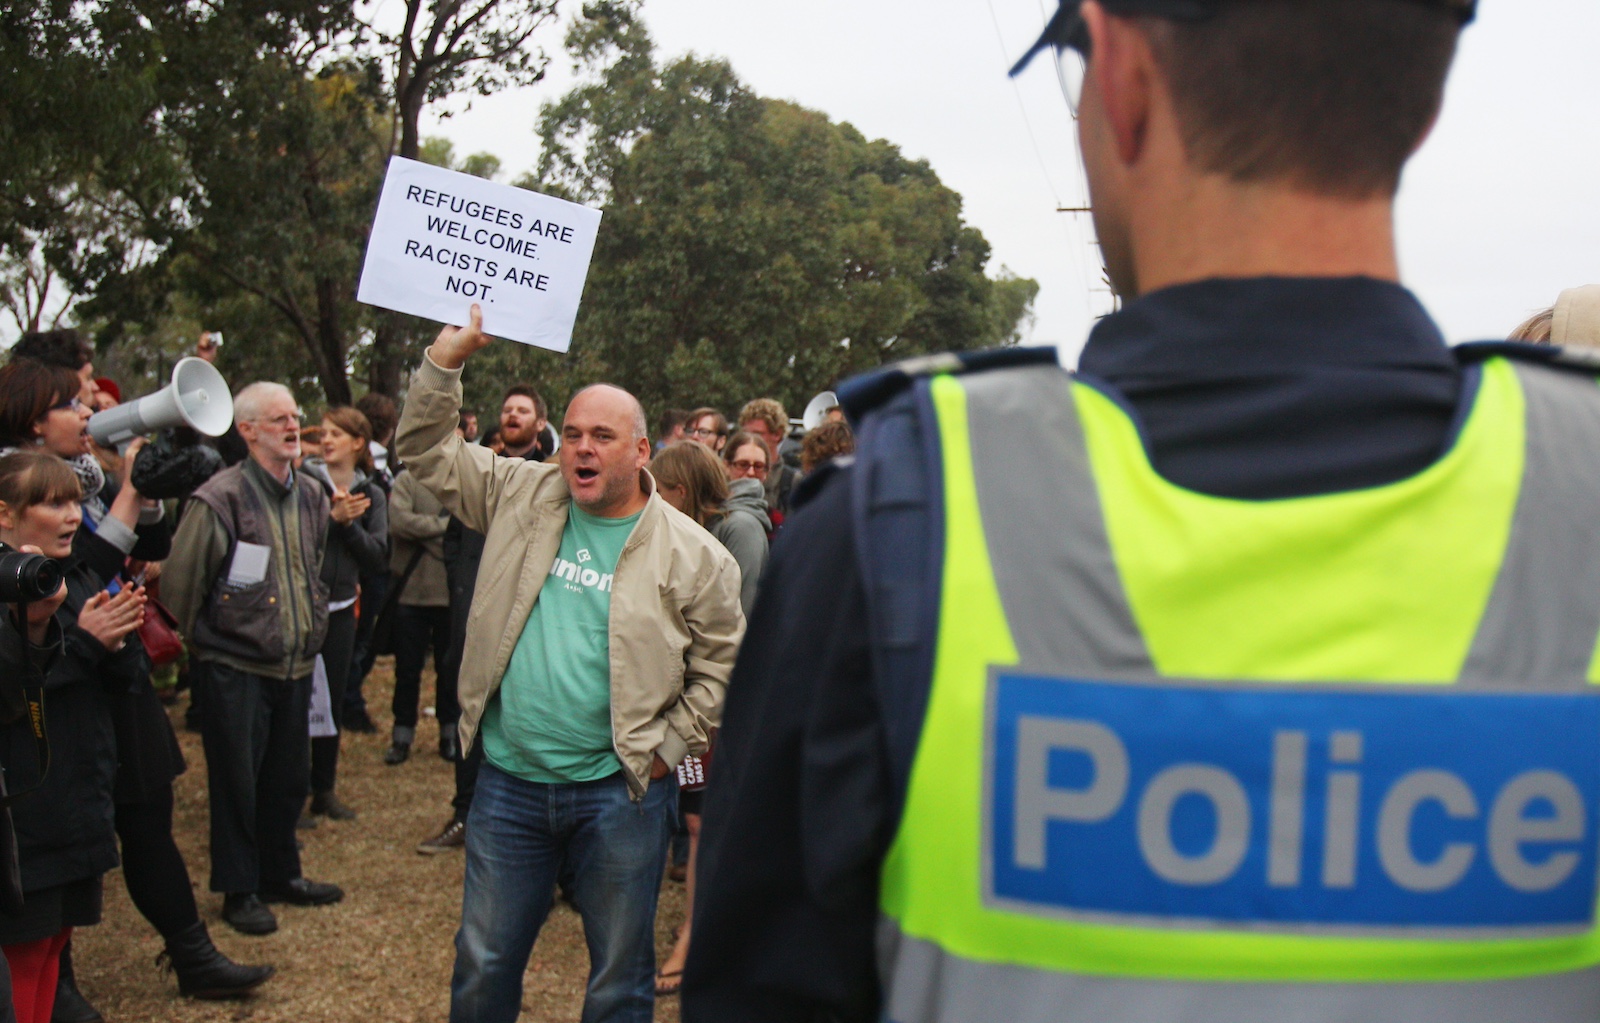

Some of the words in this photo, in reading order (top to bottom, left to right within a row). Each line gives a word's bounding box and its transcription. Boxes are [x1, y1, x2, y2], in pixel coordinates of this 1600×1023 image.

[406, 185, 523, 230] REFUGEES
[529, 219, 574, 244] ARE
[427, 215, 540, 260] WELCOME.
[405, 240, 498, 277] RACISTS
[503, 267, 549, 291] ARE
[446, 276, 494, 302] NOT.
[29, 701, 43, 738] Nikon
[1013, 714, 1587, 893] Police
